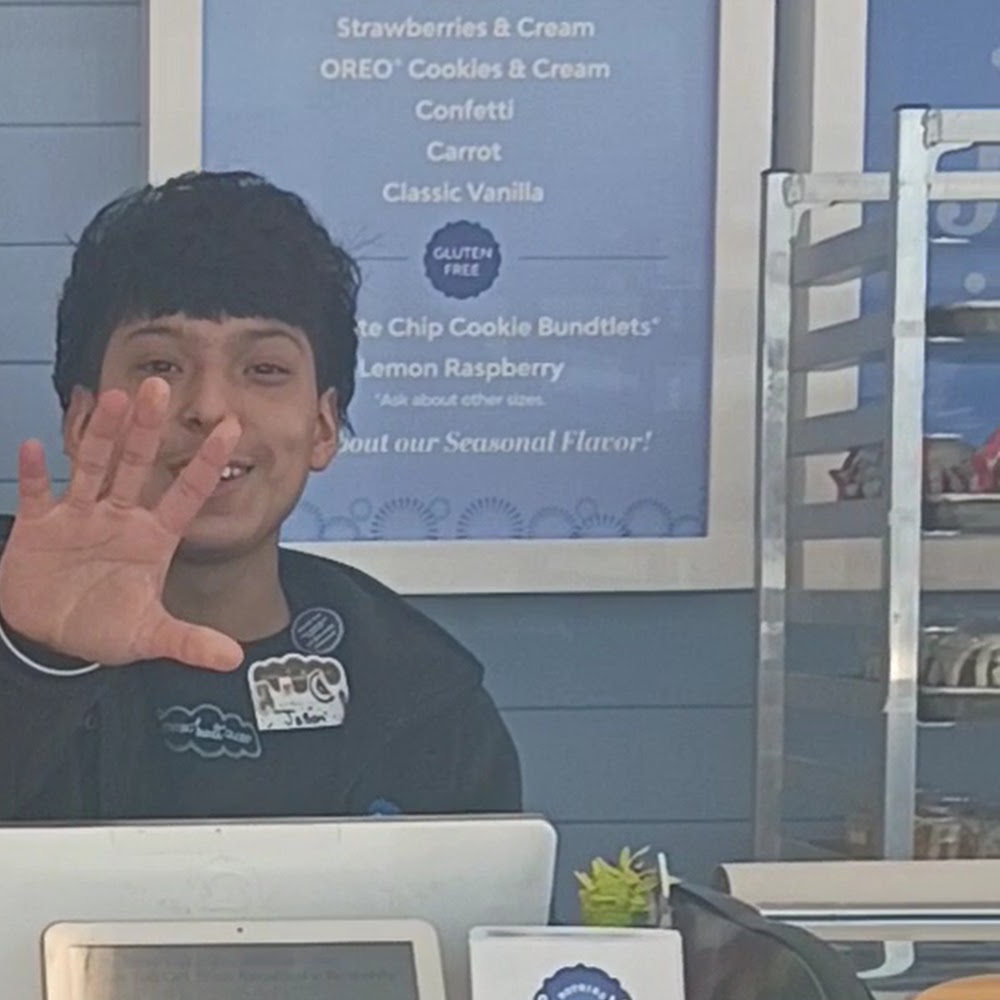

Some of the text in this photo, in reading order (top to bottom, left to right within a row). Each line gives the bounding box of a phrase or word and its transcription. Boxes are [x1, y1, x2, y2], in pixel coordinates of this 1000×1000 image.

[336, 16, 595, 38] Strawberries & Cream
[408, 58, 503, 80] Cookies
[508, 58, 527, 79] &
[532, 58, 611, 79] Cream
[415, 98, 514, 121] Confetti
[426, 140, 502, 163] Carrot
[382, 181, 544, 204] Classic Vanilla
[432, 246, 493, 262] GLUTEN
[443, 263, 480, 278] FREE
[387, 316, 444, 342] Chip
[448, 315, 533, 337] Cookie
[357, 356, 565, 383] Lemon Raspberry
[411, 392, 457, 407] about
[460, 392, 503, 407] other
[394, 436, 440, 453] our
[443, 429, 557, 453] Seasonal
[561, 429, 653, 453] Flavor!
